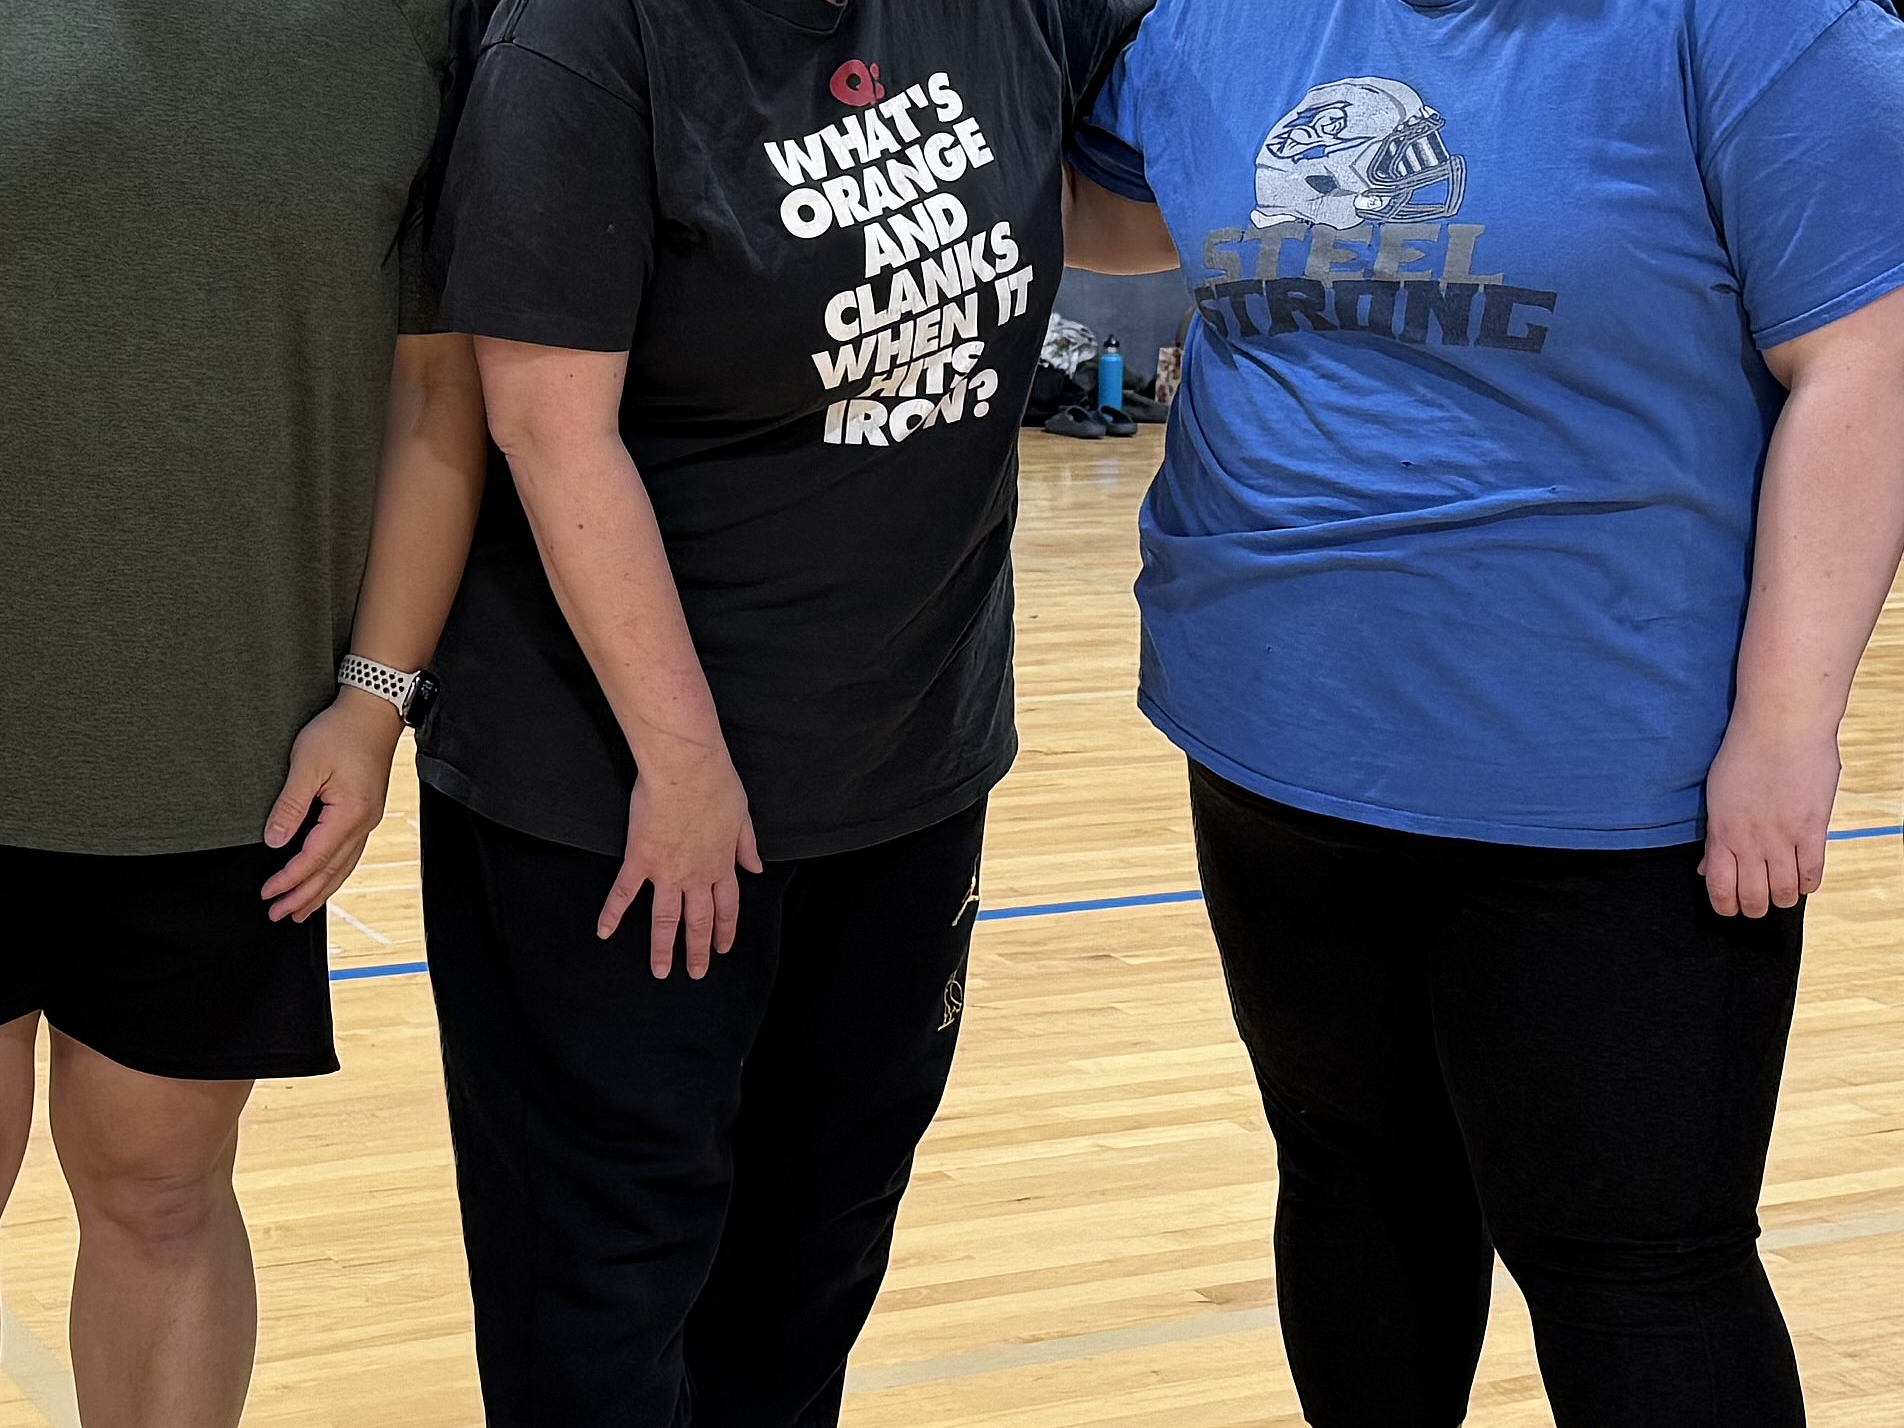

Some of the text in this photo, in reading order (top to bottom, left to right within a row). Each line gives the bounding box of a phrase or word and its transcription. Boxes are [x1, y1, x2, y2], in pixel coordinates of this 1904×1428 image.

[829, 58, 885, 107] Q:
[763, 72, 964, 186] WHAT'S
[780, 116, 994, 239] ORANGE
[864, 192, 968, 278] AND
[1202, 222, 1504, 289] STEEL
[824, 220, 1020, 341] CLANKS
[1195, 276, 1558, 354] STRONG
[811, 264, 1034, 391] WHEN IT
[823, 368, 999, 447] IRON?
[855, 340, 986, 398] HITS
